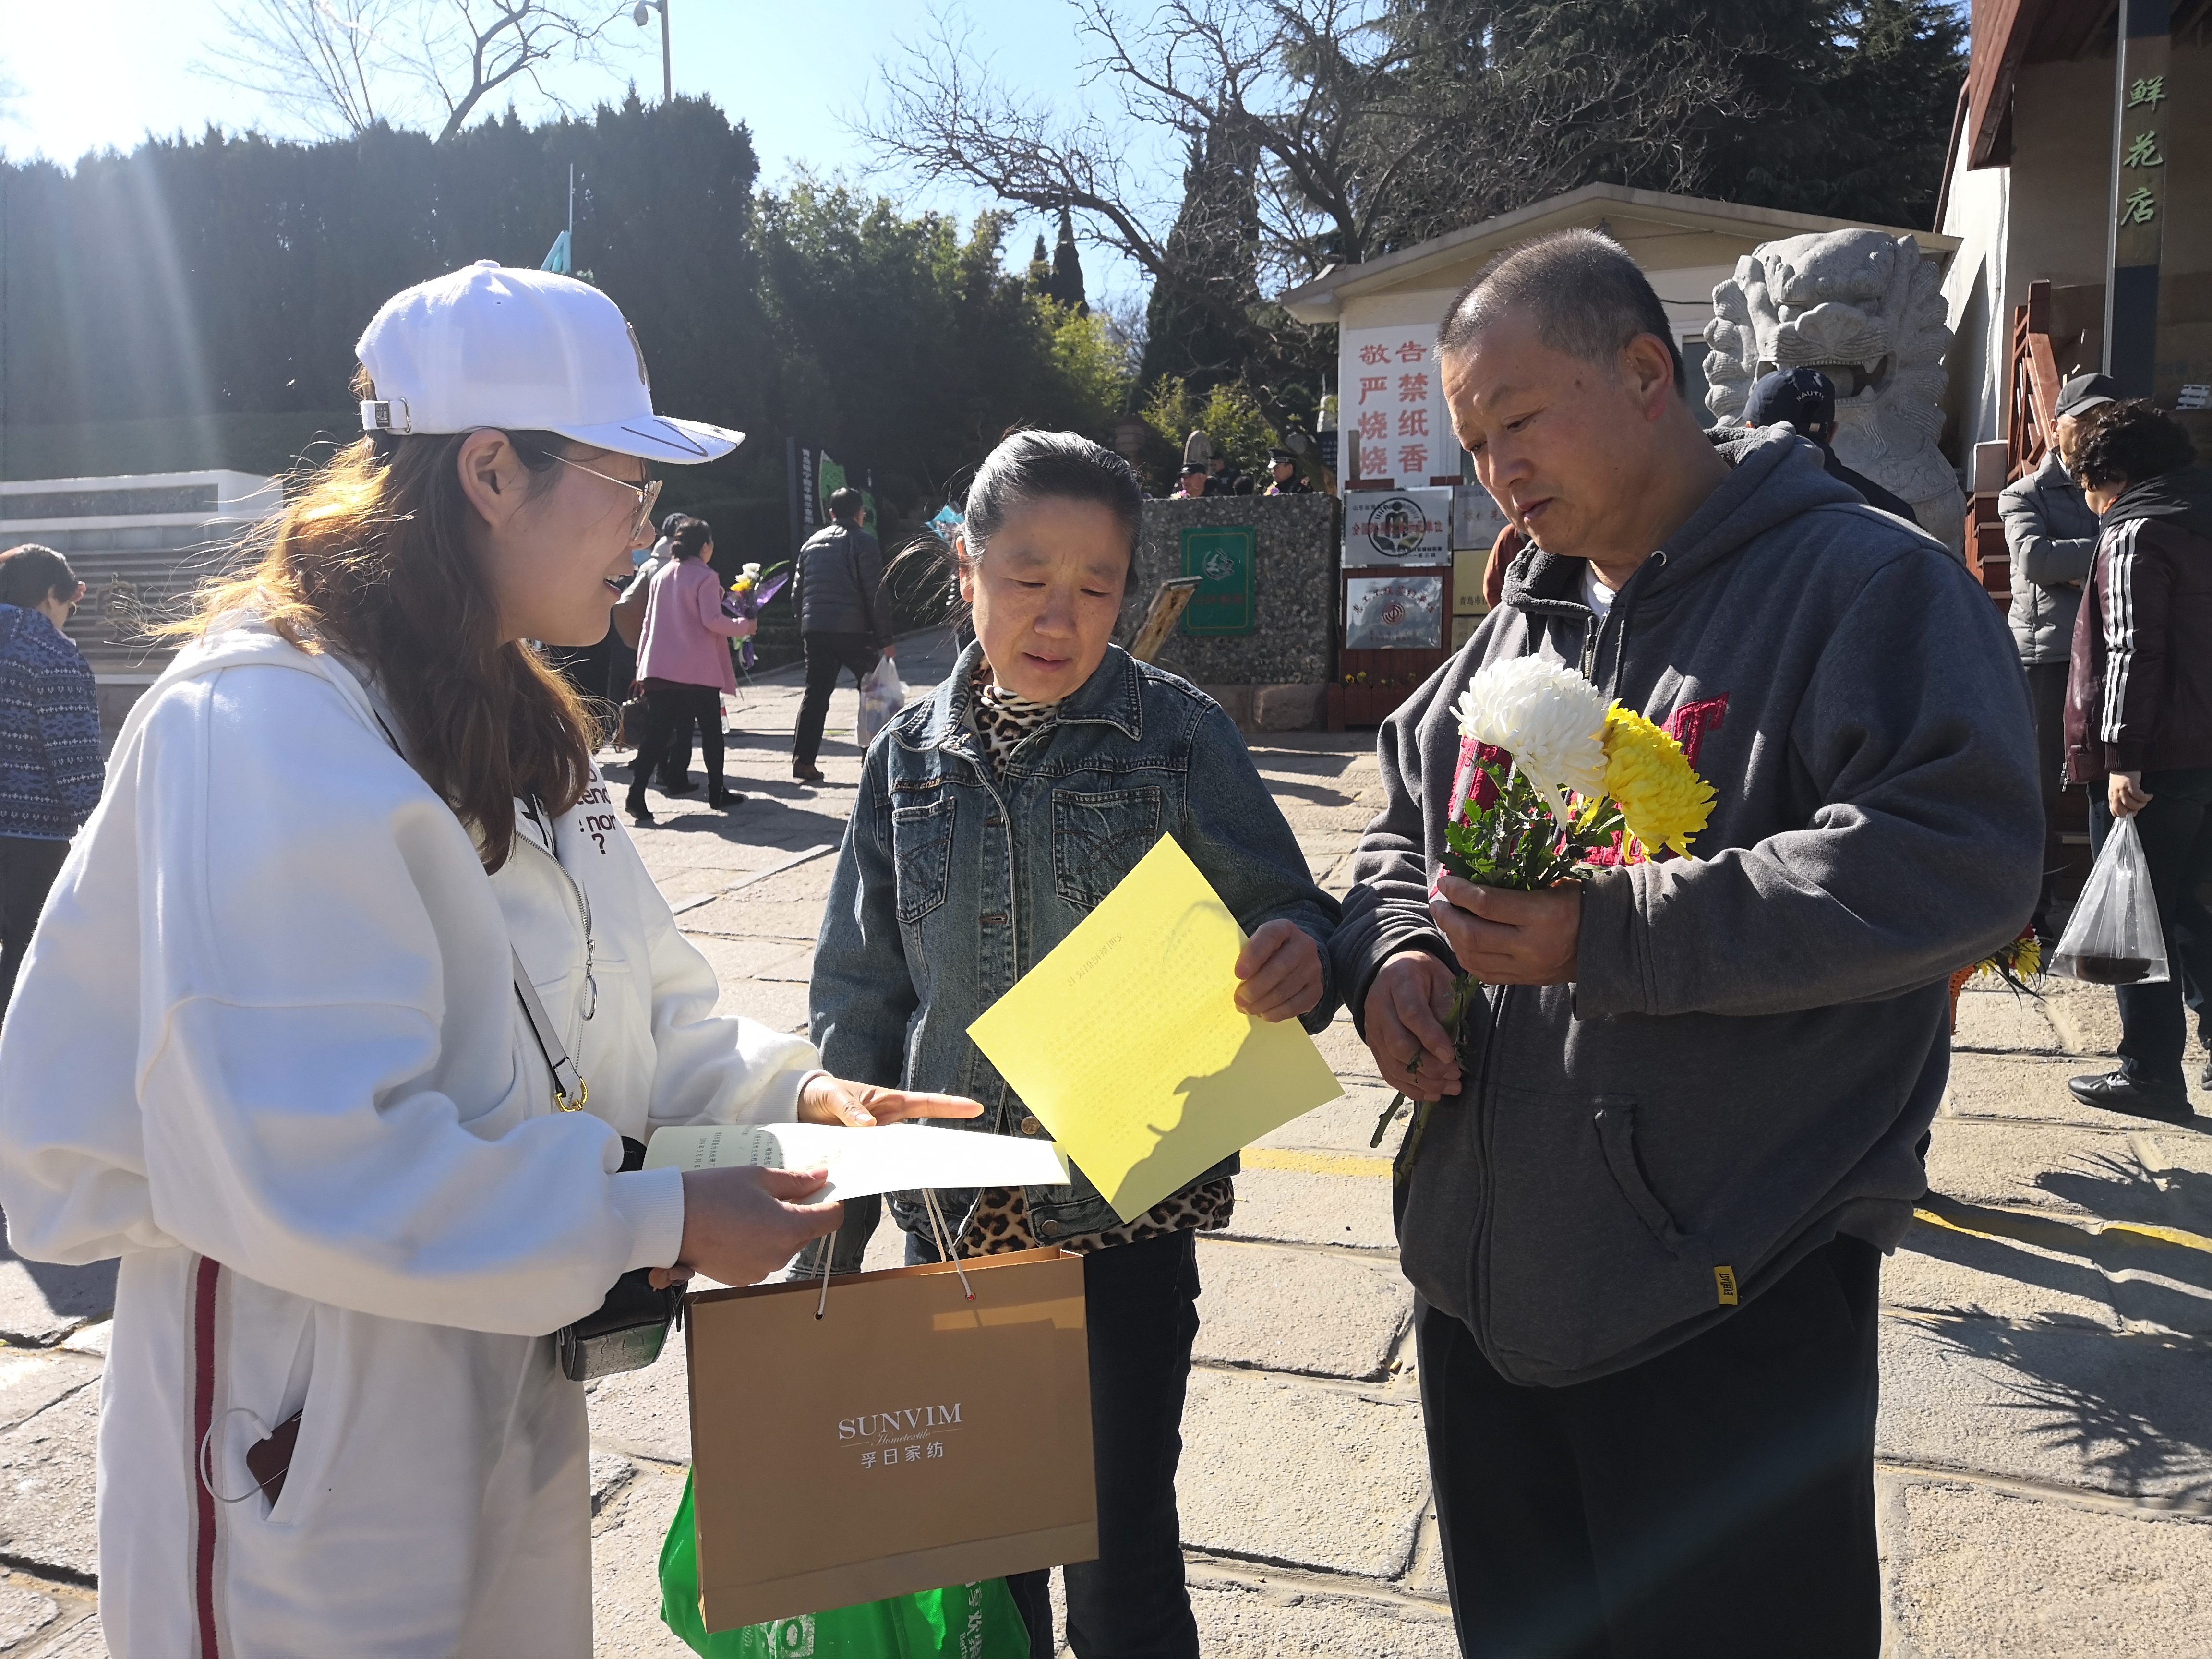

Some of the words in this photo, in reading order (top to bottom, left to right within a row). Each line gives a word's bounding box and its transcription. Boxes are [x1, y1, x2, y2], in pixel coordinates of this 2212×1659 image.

[2120, 75, 2166, 226] 鲜花店
[1359, 340, 1428, 365] 敬告
[1358, 373, 1428, 405] 严禁
[1357, 409, 1428, 440] 烧纸
[1359, 444, 1428, 475] 烧香
[591, 833, 606, 854] ?
[838, 1403, 962, 1440] SUNVIM
[870, 1429, 931, 1447] Hometextile
[861, 1441, 944, 1469] 孚日家纺
